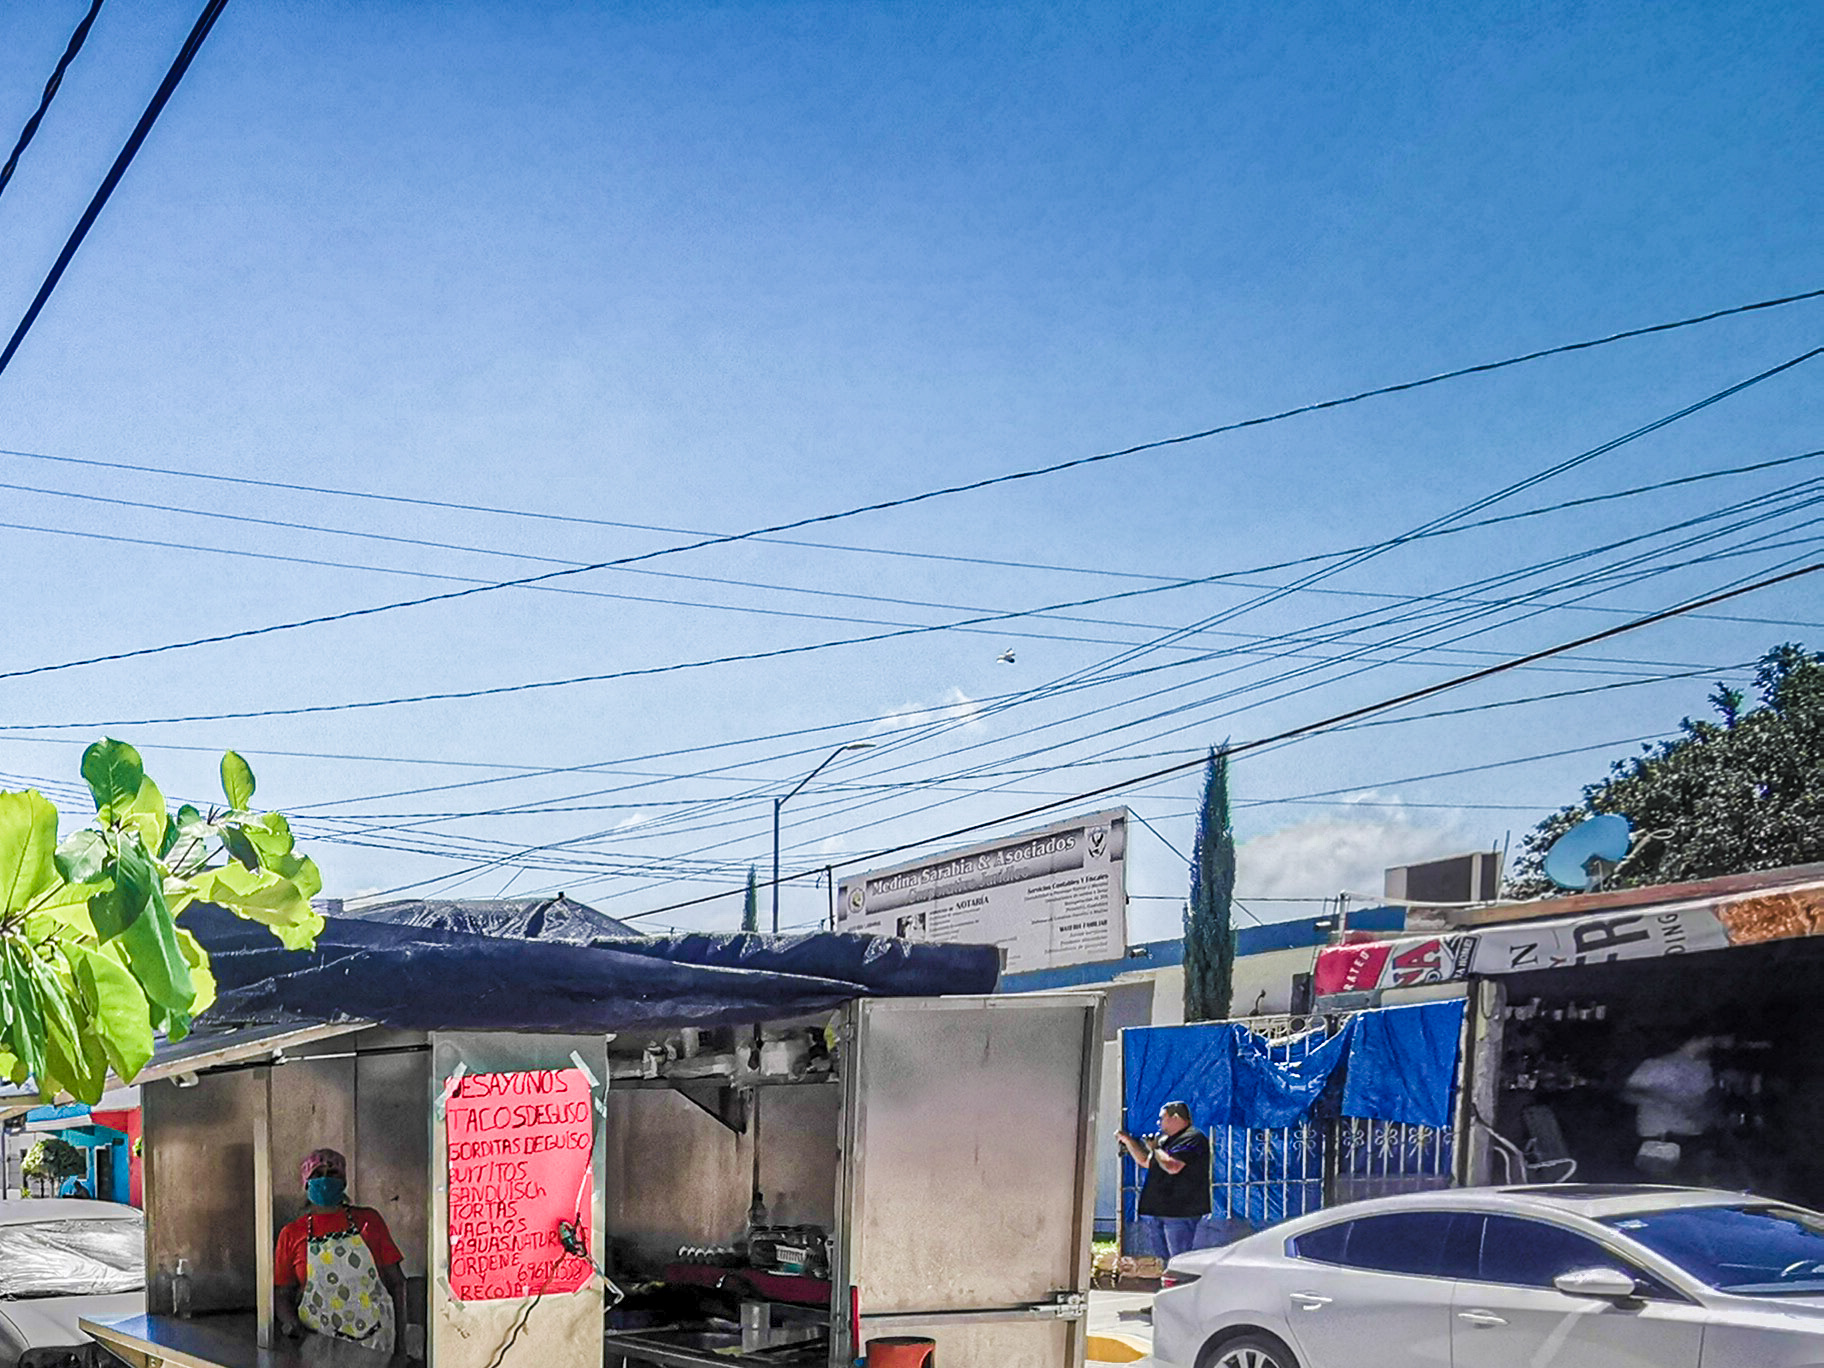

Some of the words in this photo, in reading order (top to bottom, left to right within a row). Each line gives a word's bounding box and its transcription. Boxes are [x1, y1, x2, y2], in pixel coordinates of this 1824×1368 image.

[871, 874, 920, 896] Medina
[920, 859, 974, 884] Sarabia
[977, 854, 990, 871] &
[994, 836, 1076, 866] Asociados
[956, 894, 989, 910] NOTARÍA
[450, 1200, 518, 1220] TORTAS
[453, 1252, 520, 1277] ORDENE
[479, 1273, 487, 1284] Y
